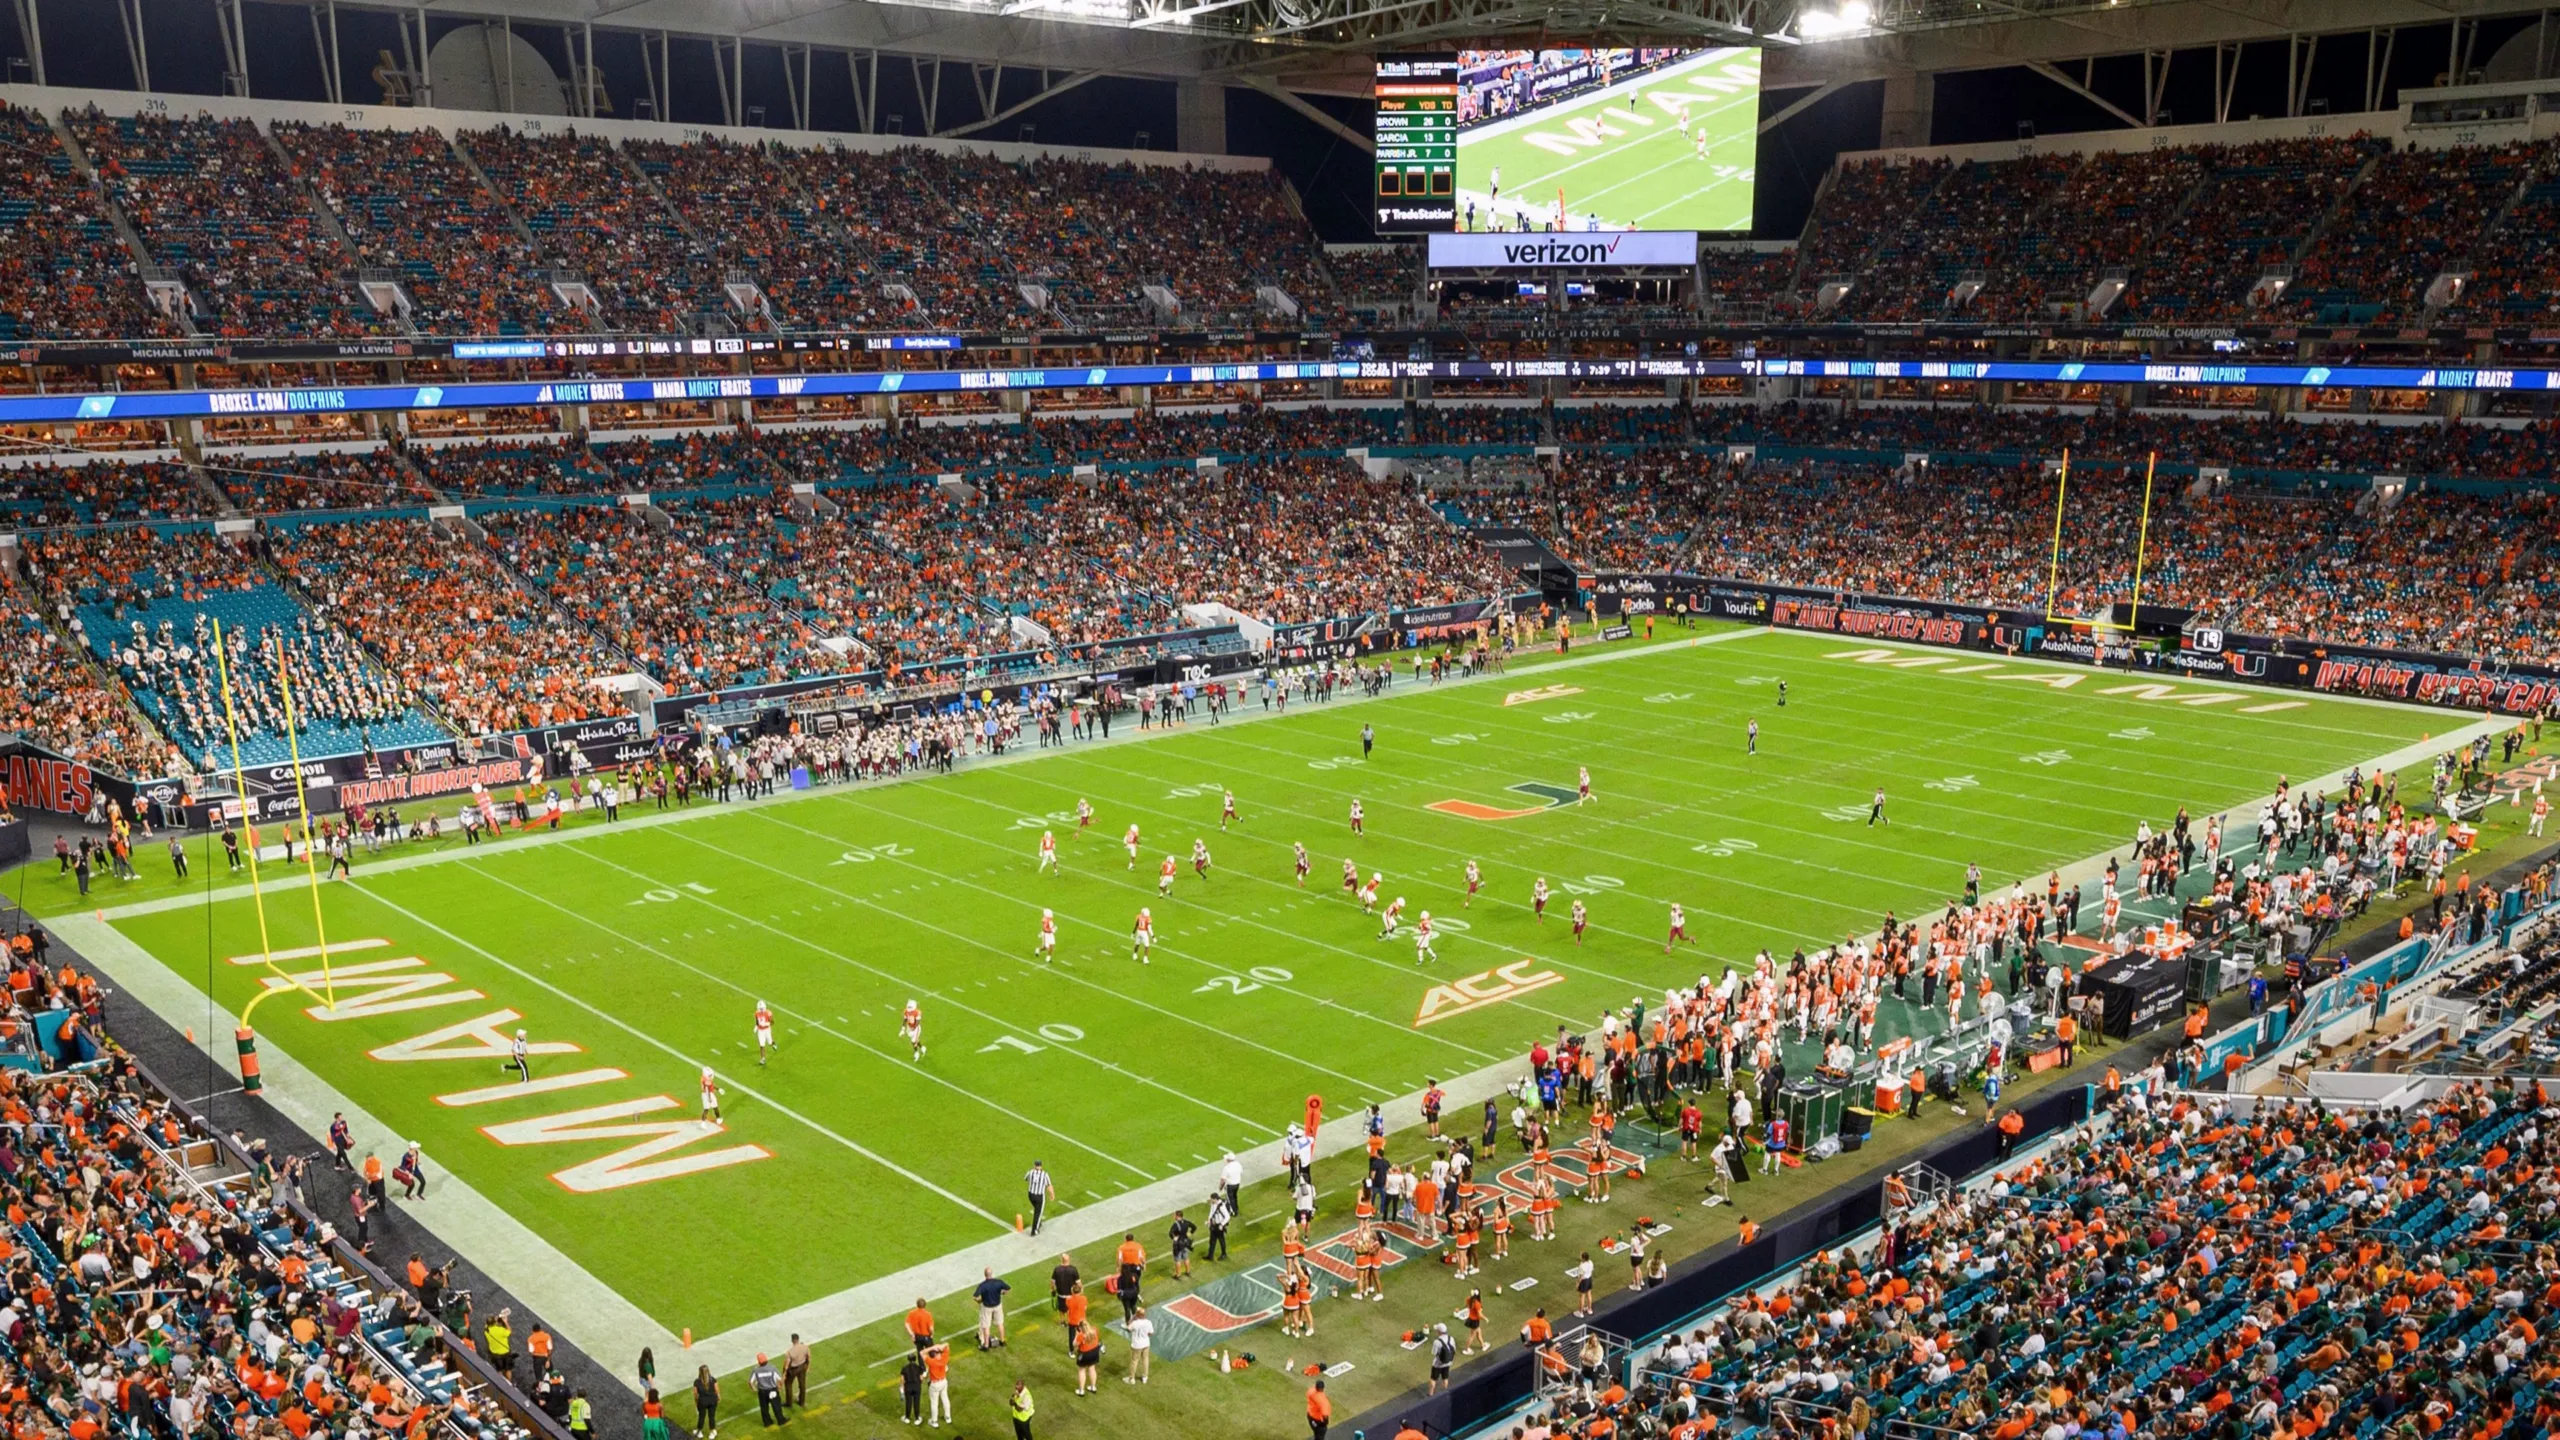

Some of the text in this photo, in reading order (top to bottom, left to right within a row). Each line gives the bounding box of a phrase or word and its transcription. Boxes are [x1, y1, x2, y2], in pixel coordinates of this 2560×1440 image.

[145, 99, 168, 112] 316
[1381, 101, 1406, 111] Player
[1441, 101, 1453, 110] TD
[344, 110, 364, 122] 317
[1376, 117, 1408, 127] BROWN
[1445, 117, 1451, 126] 0
[523, 120, 541, 131] 318
[2308, 125, 2326, 136] 331
[683, 129, 699, 140] 319
[1376, 133, 1408, 142] GARCIA
[1445, 133, 1451, 142] 0
[2150, 136, 2168, 147] 330
[2456, 133, 2476, 144] 332
[1376, 149, 1406, 158] PARRISH
[1425, 149, 1431, 158] 7
[1445, 149, 1451, 158] 0
[1392, 209, 1453, 221] TradeStation
[1504, 238, 1607, 264] verizon
[1012, 336, 1029, 344] REED
[1521, 329, 1620, 338] RING HONOR
[2123, 328, 2236, 338] NATIONAL CHAMPIONS
[133, 348, 181, 358] MICHAEL
[184, 347, 214, 357] IRVIN
[340, 346, 393, 354] RAY LEWIS
[575, 343, 597, 355] FSU
[650, 341, 670, 354] MIA
[1407, 362, 1433, 370] TULANE
[1589, 366, 1610, 376] 7:39
[1649, 361, 1683, 369] SYRACUSE
[1850, 362, 1875, 377] MONEY
[1875, 361, 1900, 377] GRATIS
[1950, 364, 1976, 378] MONEY
[1215, 366, 1236, 381] MONEY
[1237, 365, 1259, 380] GRATIS
[2438, 371, 2514, 388] MONEY GRATIS
[555, 383, 624, 401] MONEY GRATIS
[653, 379, 751, 398] MANDA MONEY GRATIS
[209, 390, 345, 412] BROXEL.COM/DOLPHINS
[1725, 599, 1759, 616] YouFit
[1773, 600, 1838, 629] MAMI
[2041, 640, 2095, 655] AutoNation
[2201, 632, 2216, 648] 19
[1182, 664, 1212, 681] TOC
[1822, 648, 2310, 713] MIAMI
[1504, 683, 1586, 706] ACC
[576, 727, 616, 742] Hialeah
[2108, 727, 2156, 741] 10
[422, 746, 452, 760] Online
[2019, 749, 2073, 766] 20
[341, 760, 523, 806] MIAMI HURRICANES
[1923, 774, 1981, 793] 30
[841, 842, 915, 865] 20
[1698, 837, 1759, 858] 50
[643, 880, 718, 903] 10
[1562, 874, 1625, 896] 40
[1211, 966, 1295, 997] 20
[1412, 957, 1567, 1029] ACC
[995, 1023, 1086, 1056] 10
[226, 938, 777, 1194] MIAMI
[1640, 1417, 1652, 1433] 17
